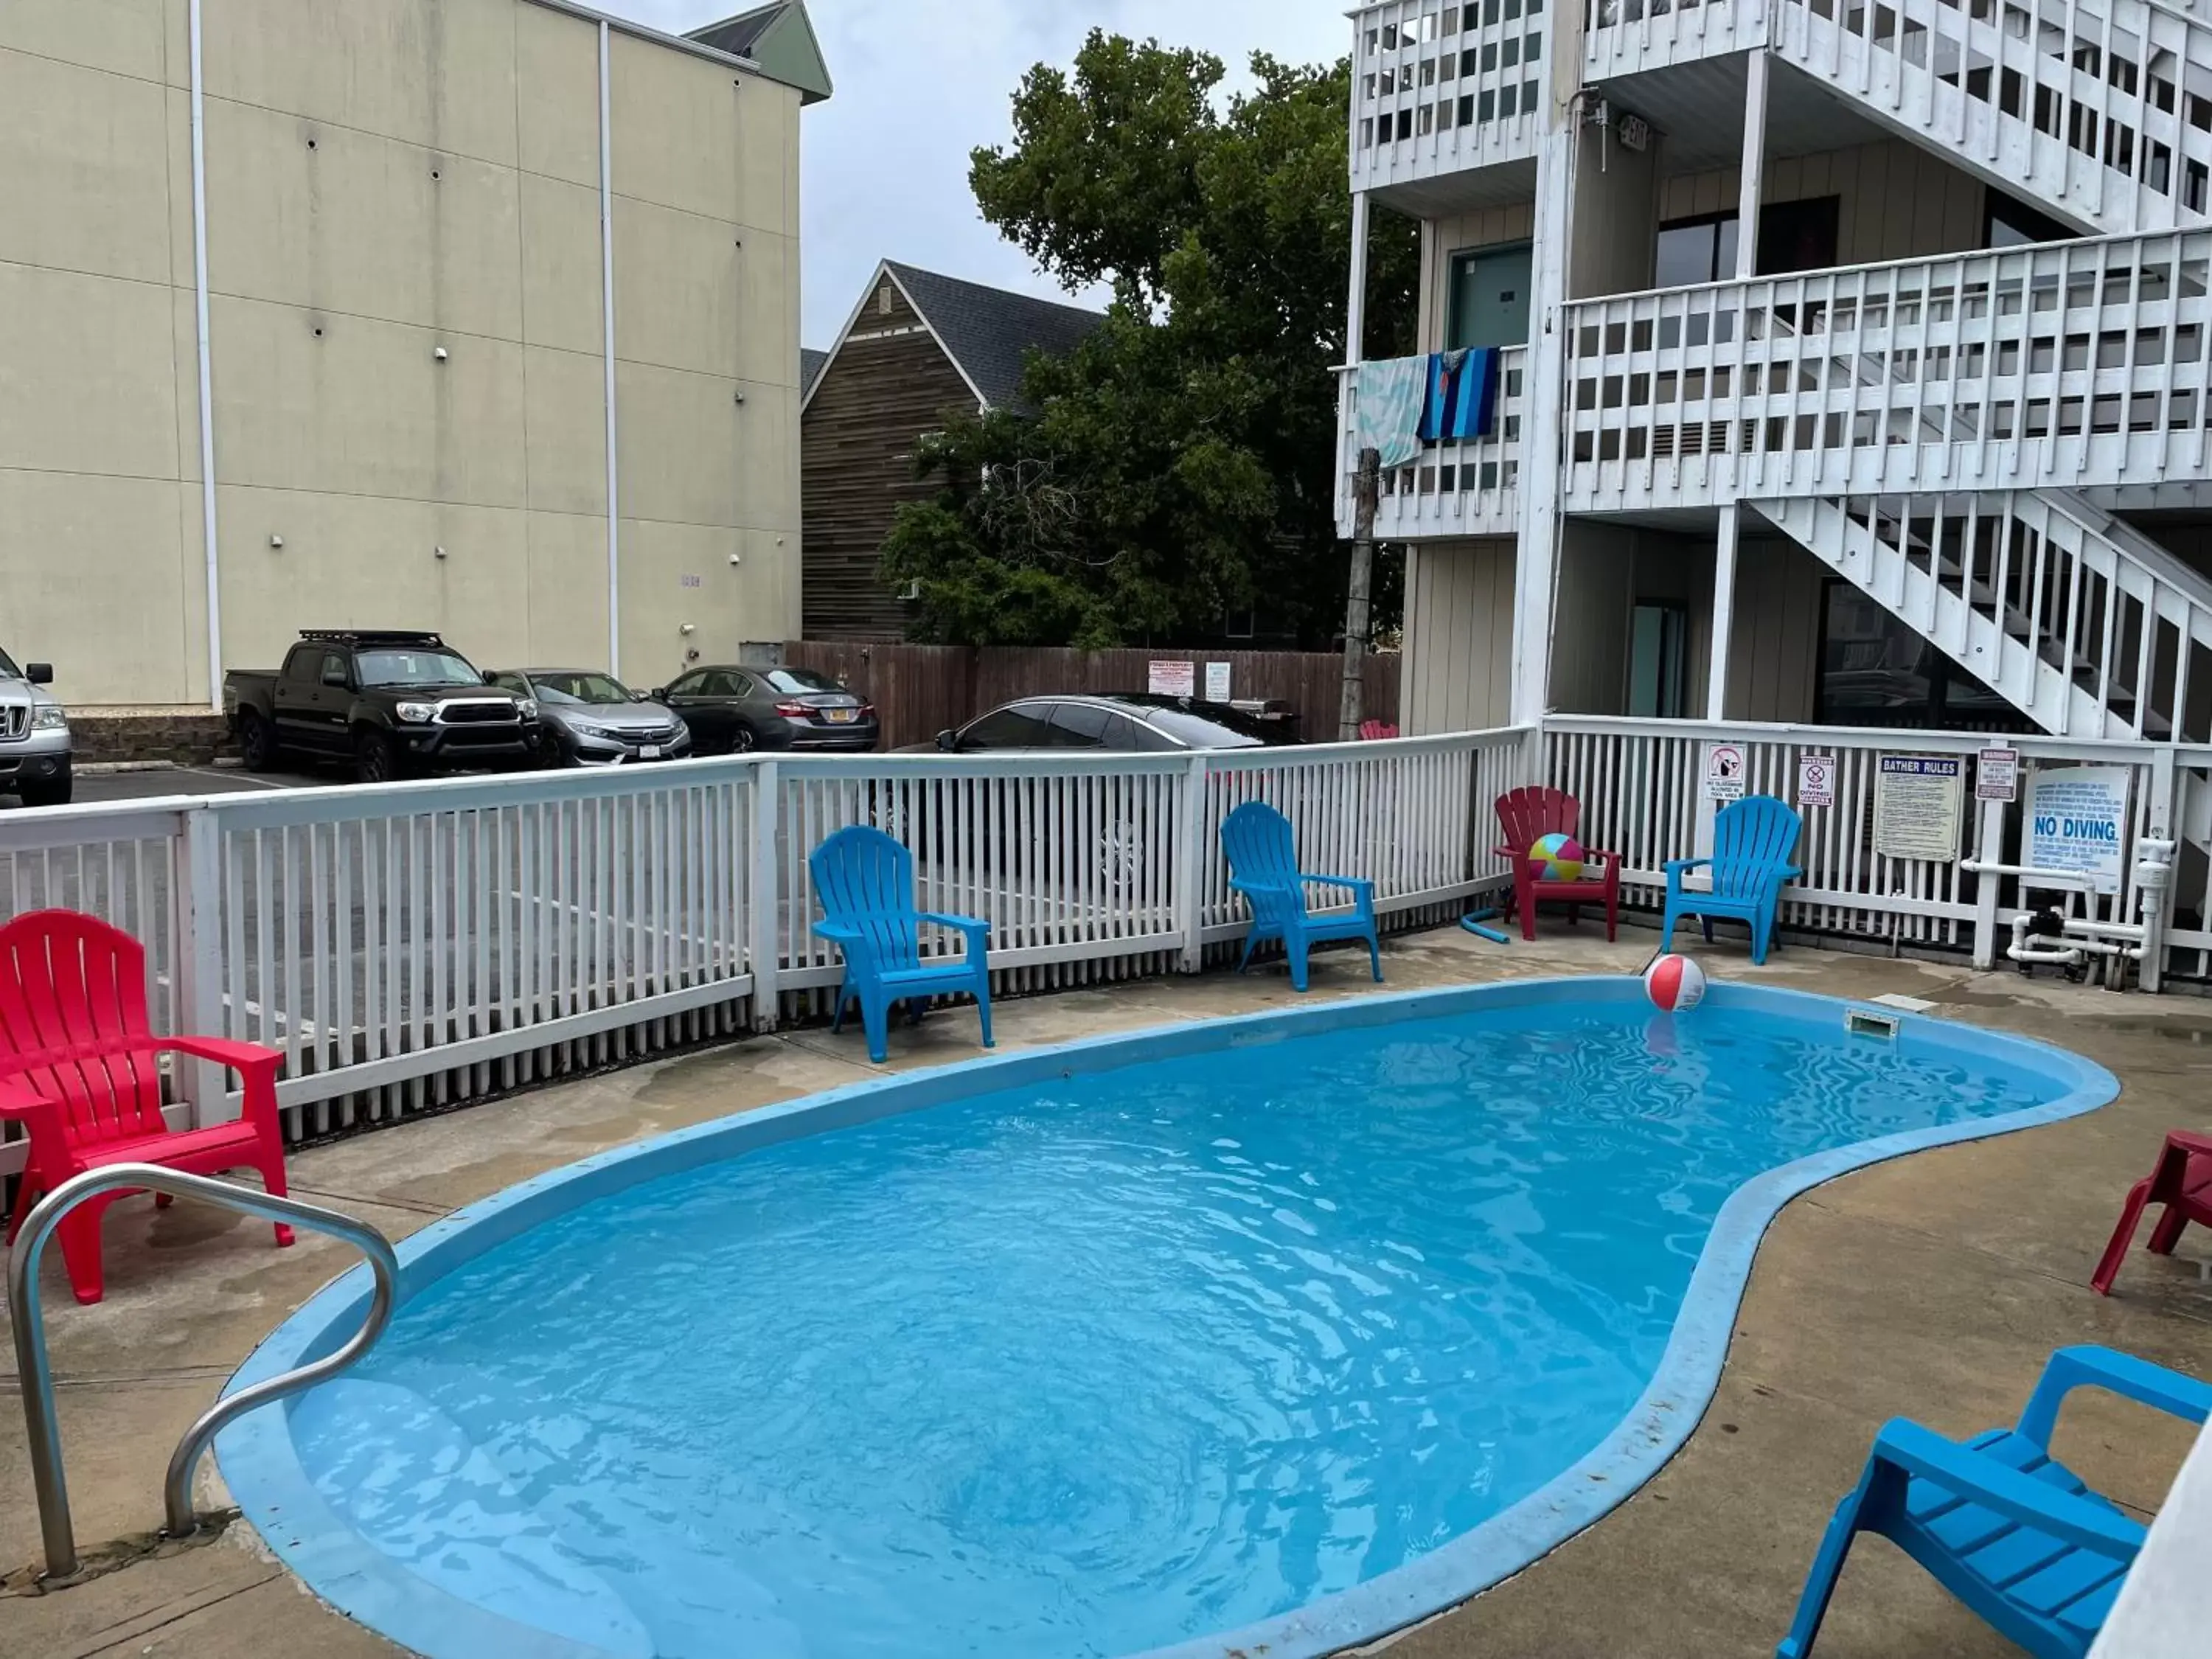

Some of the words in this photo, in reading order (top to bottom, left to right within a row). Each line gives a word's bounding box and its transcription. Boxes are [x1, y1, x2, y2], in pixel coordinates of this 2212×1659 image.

[1883, 759, 1919, 773] BATHER
[1924, 762, 1955, 774] RULES
[2034, 817, 2056, 835] NO
[2063, 818, 2119, 841] DIVING.
